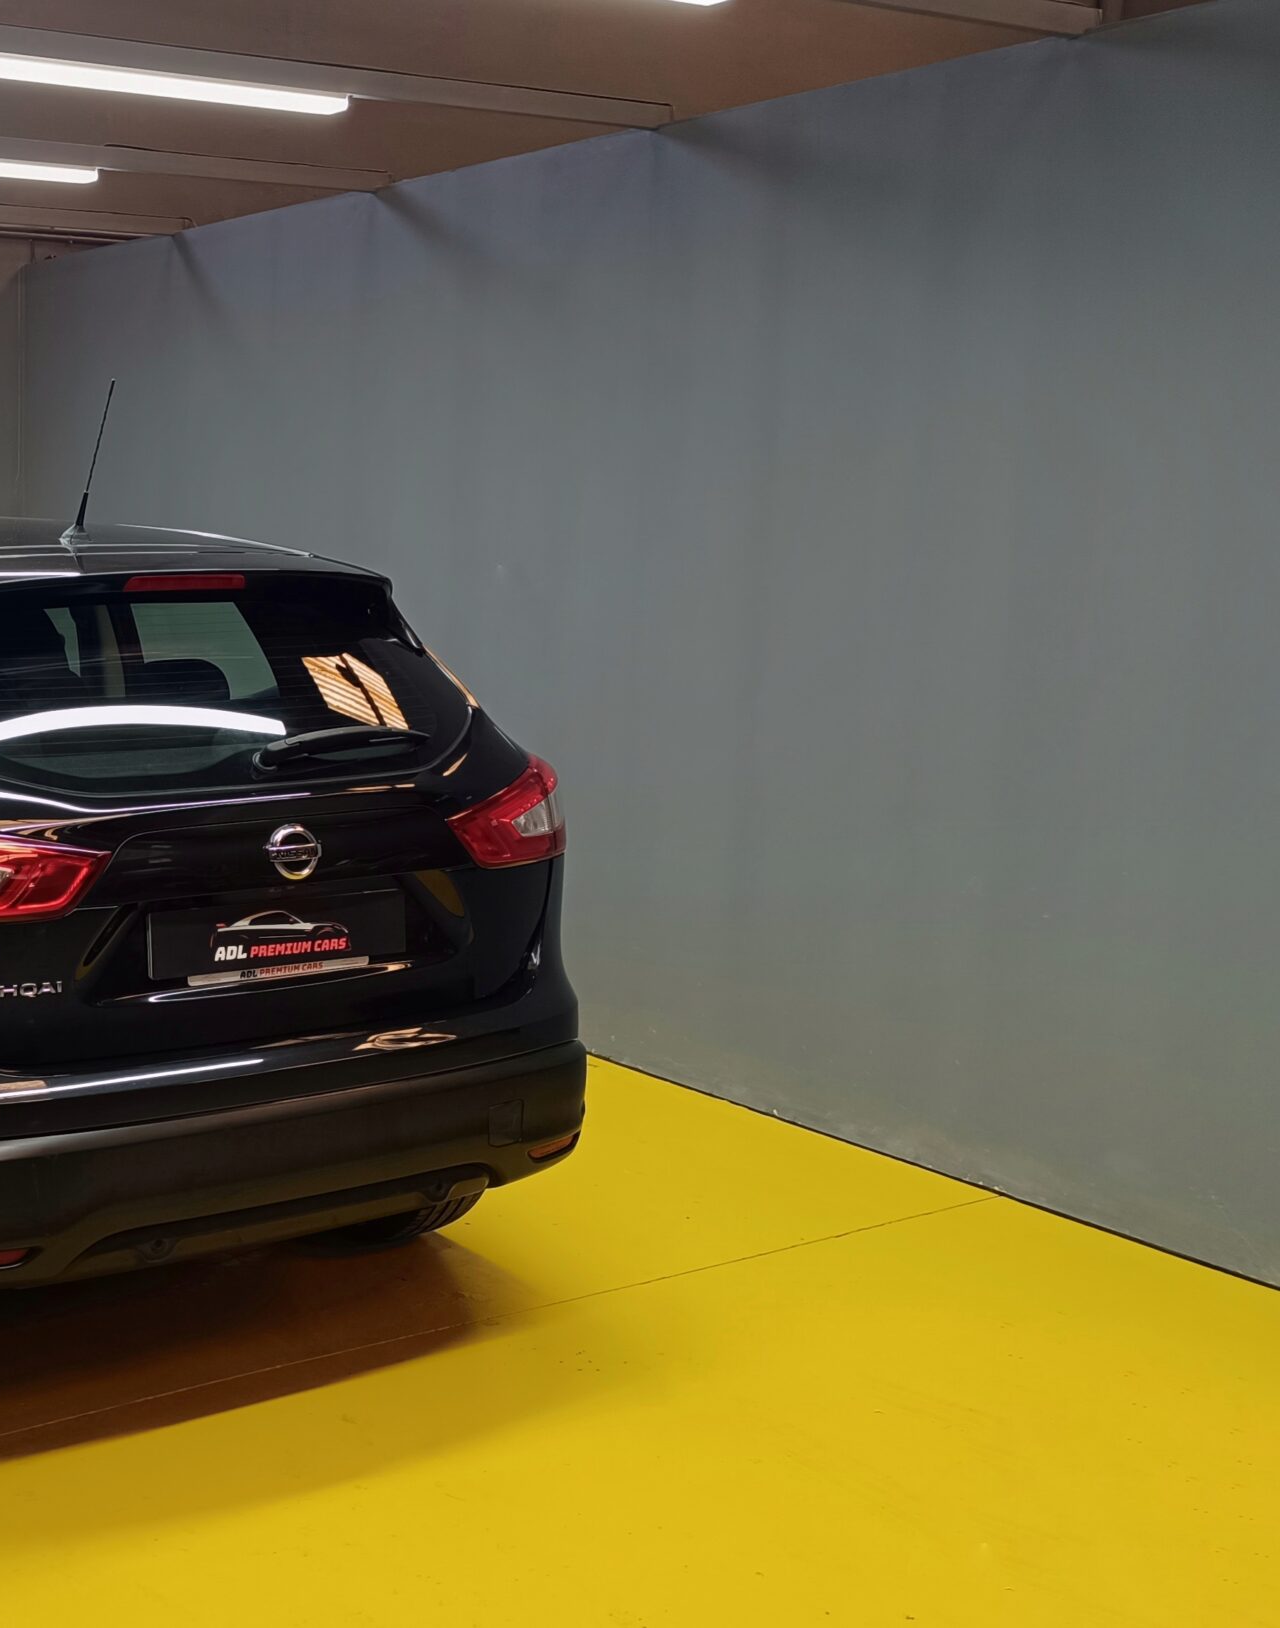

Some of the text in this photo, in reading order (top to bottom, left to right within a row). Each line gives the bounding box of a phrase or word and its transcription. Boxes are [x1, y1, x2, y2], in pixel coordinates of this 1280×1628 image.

[214, 937, 348, 962] ADL PREMIUM CARS
[239, 961, 324, 979] ADL PREMIUM CARS
